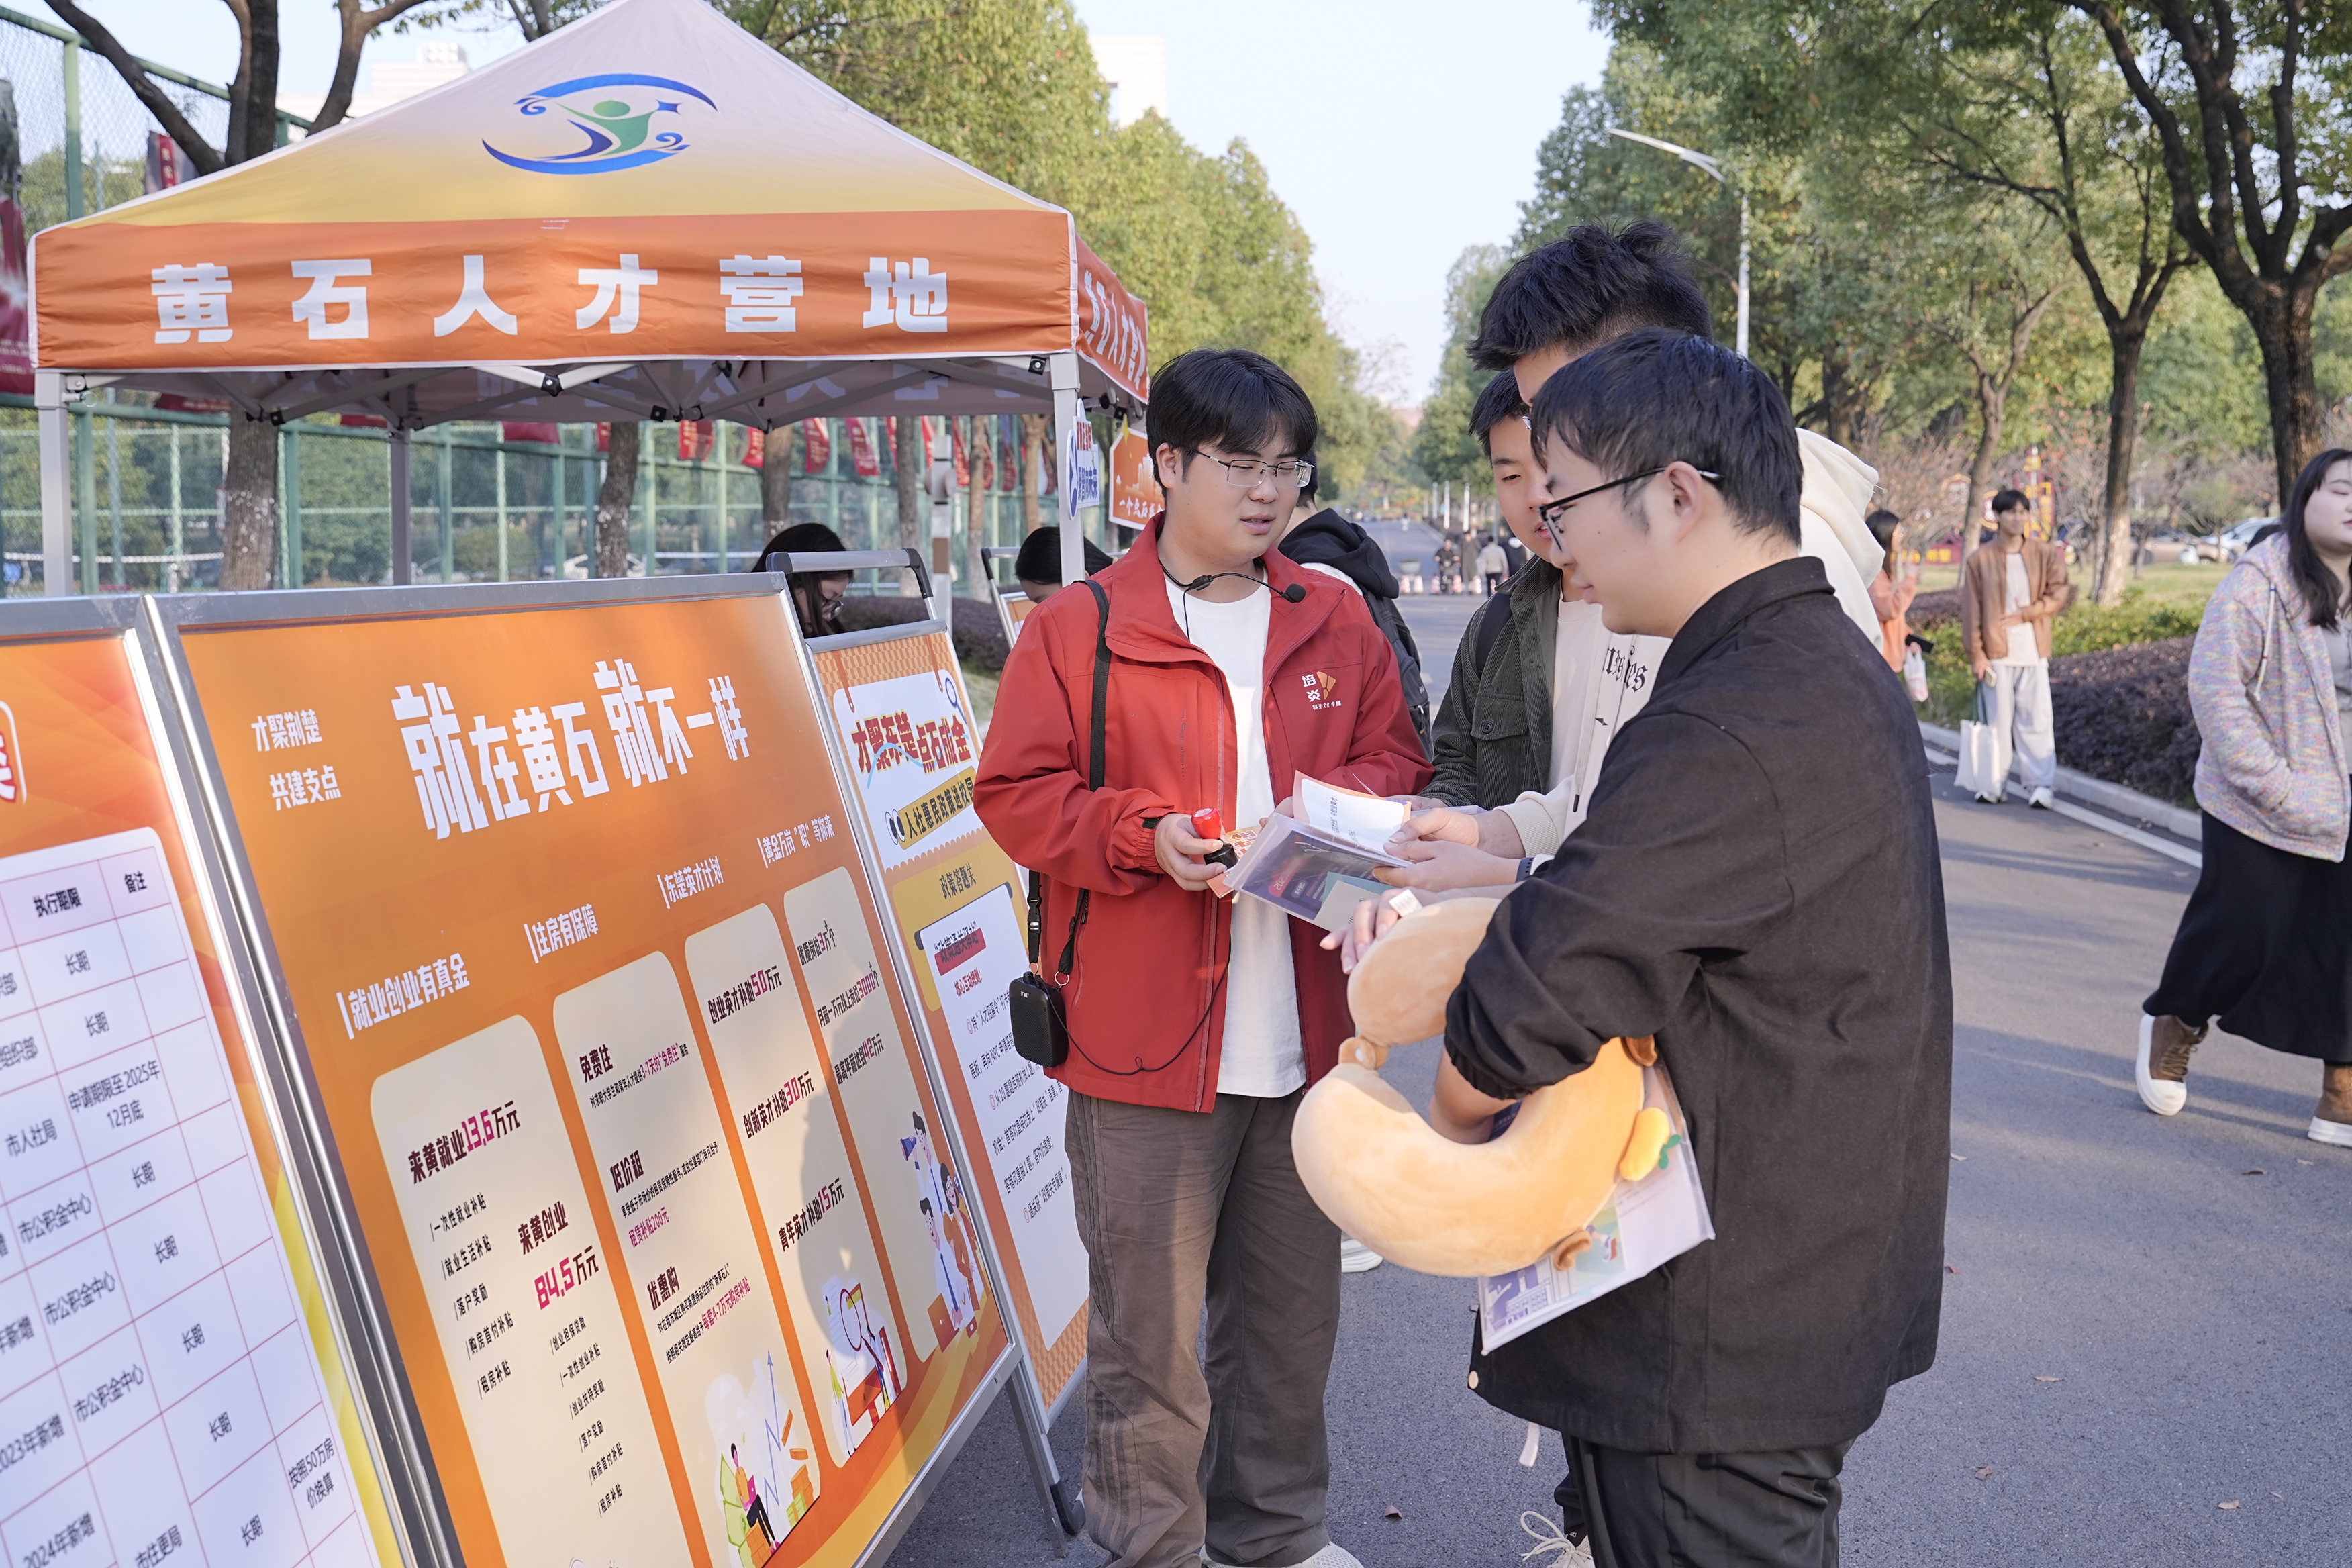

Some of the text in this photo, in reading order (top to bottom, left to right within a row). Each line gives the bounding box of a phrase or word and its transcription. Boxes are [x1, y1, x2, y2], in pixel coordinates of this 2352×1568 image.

[151, 253, 948, 344] 黄石人才营地
[251, 708, 322, 752] 才聚荆楚
[391, 658, 750, 840] 就在黄石 就不一样
[270, 765, 342, 811] 共建支点
[124, 871, 148, 894] 备注
[939, 863, 977, 900] 政策答题关
[34, 887, 82, 918] 执行期限
[531, 903, 599, 958] 住房有保障
[64, 950, 91, 975] 长期
[348, 952, 471, 1032] 就业创业有真金
[708, 965, 783, 1024] 创业英才补助50万元
[85, 1011, 110, 1037] 长期
[579, 1044, 614, 1083] 免费住
[834, 1033, 885, 1085] 最高年薪达到42万元
[68, 1059, 160, 1113] 申请期限至2025年
[743, 1071, 814, 1139] 创新英才补助30万元
[107, 1099, 144, 1128] 12月底
[5, 1118, 58, 1157] 市人社局
[132, 1161, 156, 1189] 长期
[609, 1150, 644, 1193] 低价租
[17, 1193, 92, 1244] 市公积金中心
[434, 1192, 487, 1233] 一次性就业补贴
[518, 1200, 569, 1255] 来黄创业
[628, 1206, 670, 1248] 租赁补贴200元
[779, 1177, 844, 1252] 青年英才补助15万元
[154, 1235, 179, 1264] 长期
[444, 1234, 493, 1276] 就业生活补贴
[44, 1271, 116, 1326] 市公积金中心
[457, 1283, 489, 1318] 落户奖励
[647, 1265, 681, 1311] 优惠购
[181, 1322, 205, 1353] 长期
[469, 1310, 514, 1357] 购房首付补贴
[552, 1315, 587, 1351] 创业担保贷款
[480, 1359, 512, 1395] 租房补贴
[562, 1342, 601, 1379] 一次性创业补贴
[74, 1363, 144, 1423] 市公积金中心
[572, 1379, 605, 1416] 创业扶持奖励
[209, 1412, 233, 1442] 长期
[581, 1419, 604, 1449] 落户奖励
[288, 1437, 335, 1490] 按照50万房
[591, 1441, 624, 1482] 购房首付补贴
[306, 1471, 335, 1510] 价换算
[600, 1483, 623, 1515] 租房补贴
[240, 1514, 264, 1547] 长期
